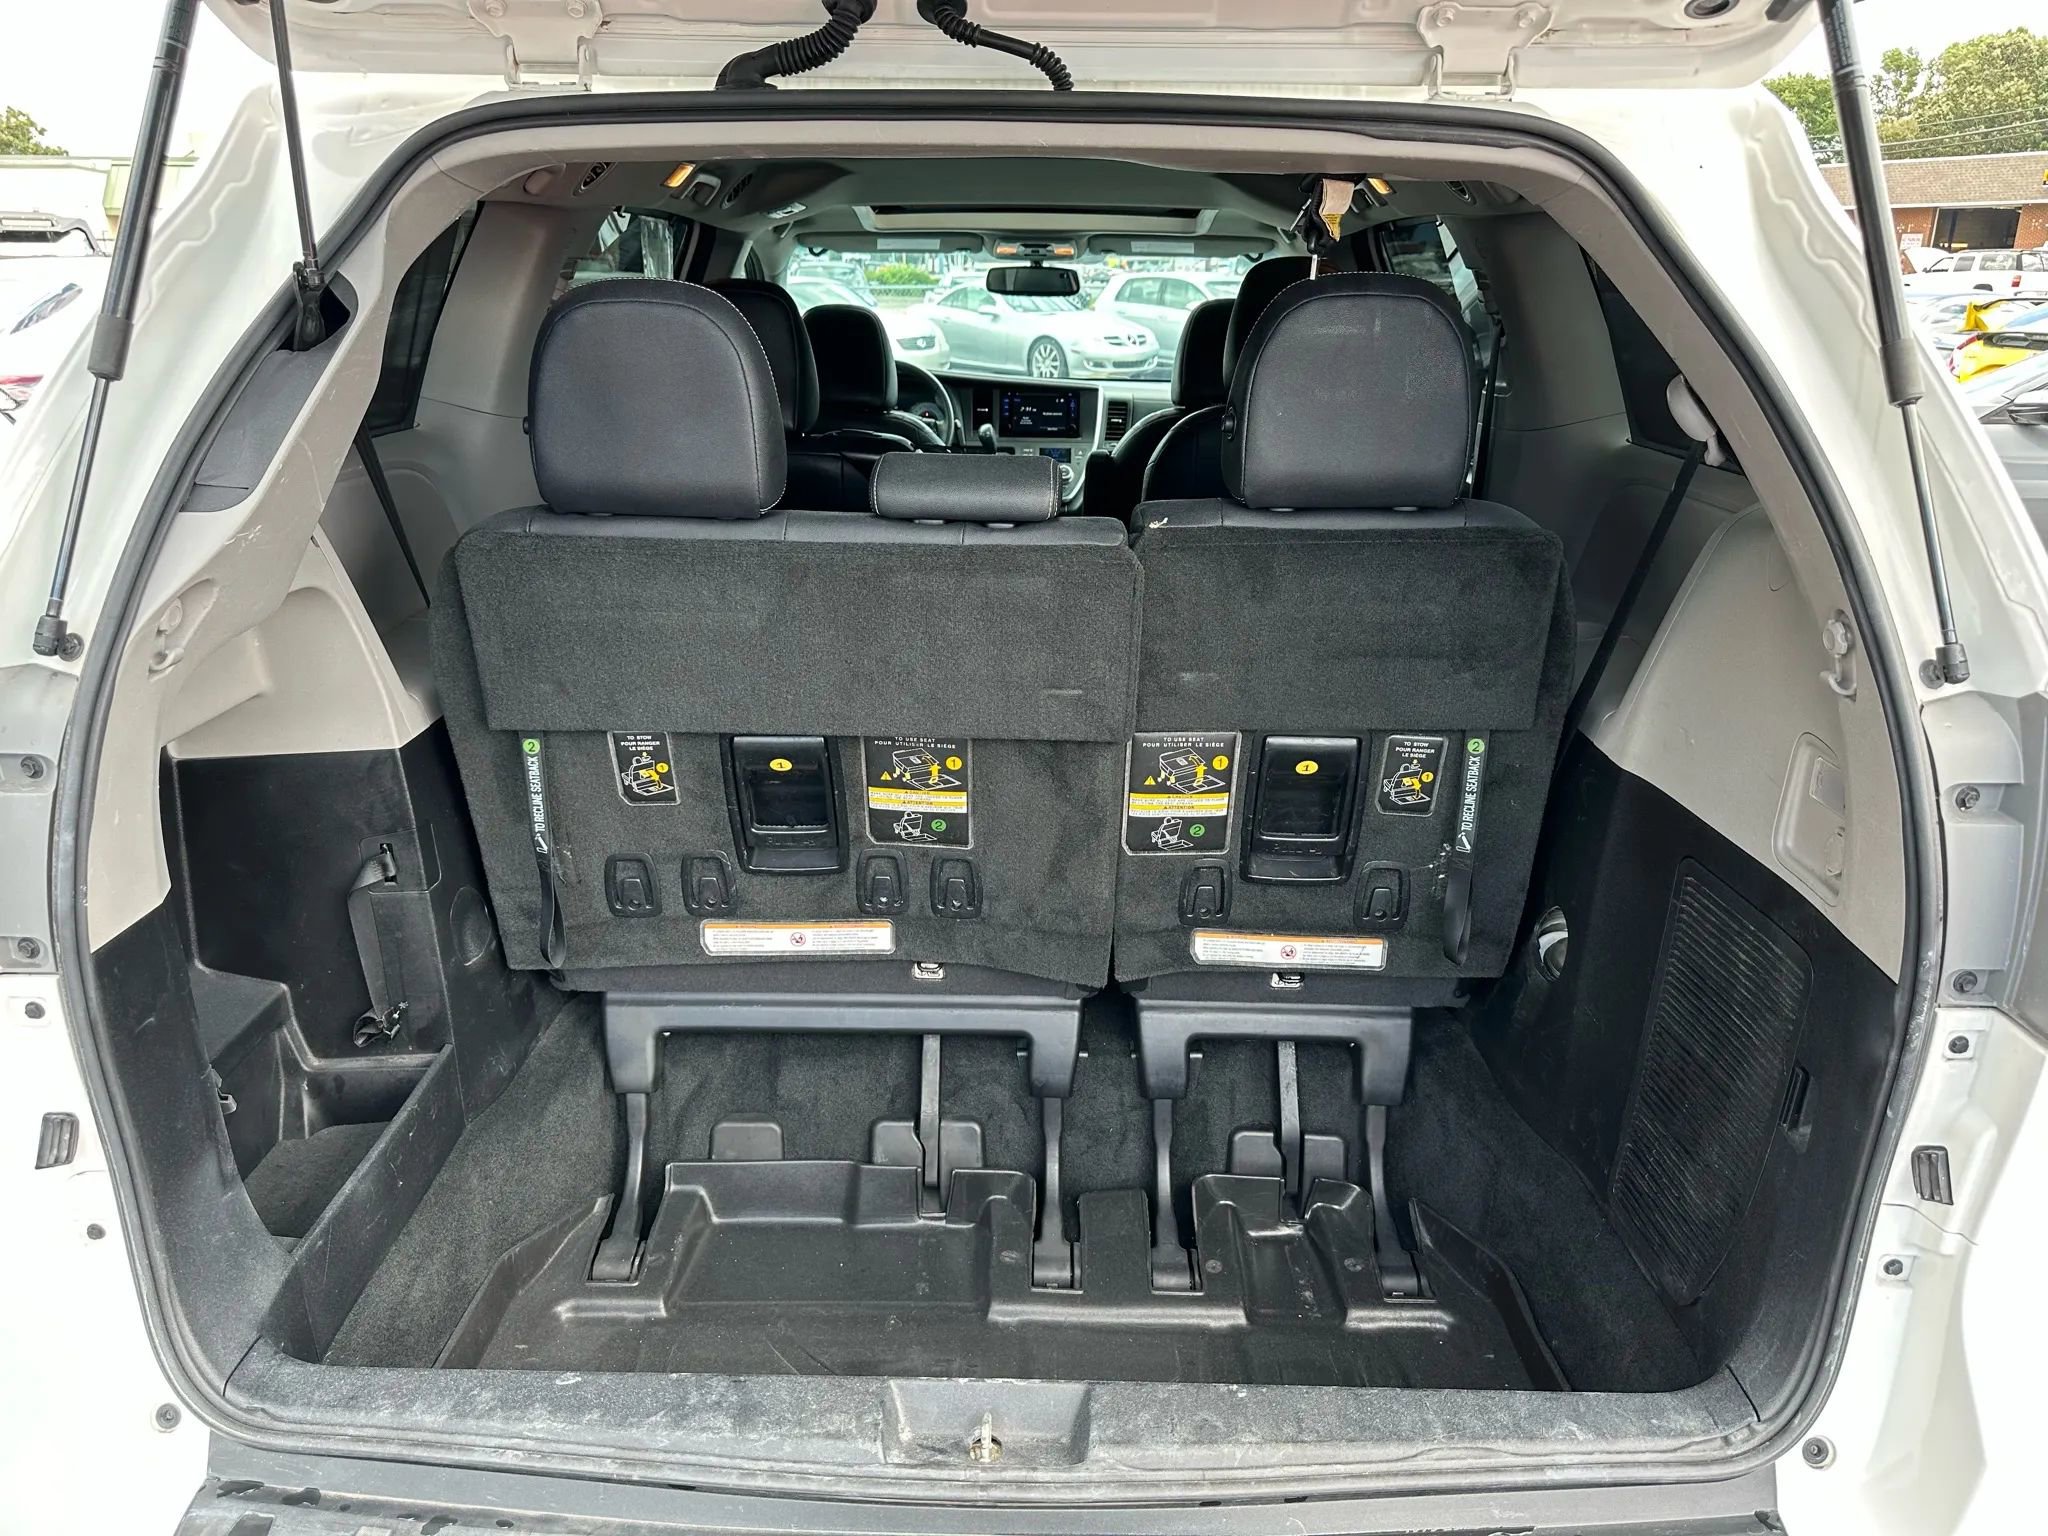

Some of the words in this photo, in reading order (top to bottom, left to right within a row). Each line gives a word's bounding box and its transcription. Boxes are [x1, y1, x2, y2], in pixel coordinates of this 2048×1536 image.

[527, 741, 536, 752] 2
[1472, 741, 1480, 752] 2
[527, 756, 542, 793] SEATBACK
[1465, 755, 1481, 792] SEATBACK
[531, 793, 545, 822] RECLINE
[1462, 792, 1477, 821] RECLINE
[534, 822, 546, 833] TO
[935, 821, 943, 830] 2
[1193, 825, 1202, 835] 2
[1461, 821, 1473, 831] TO
